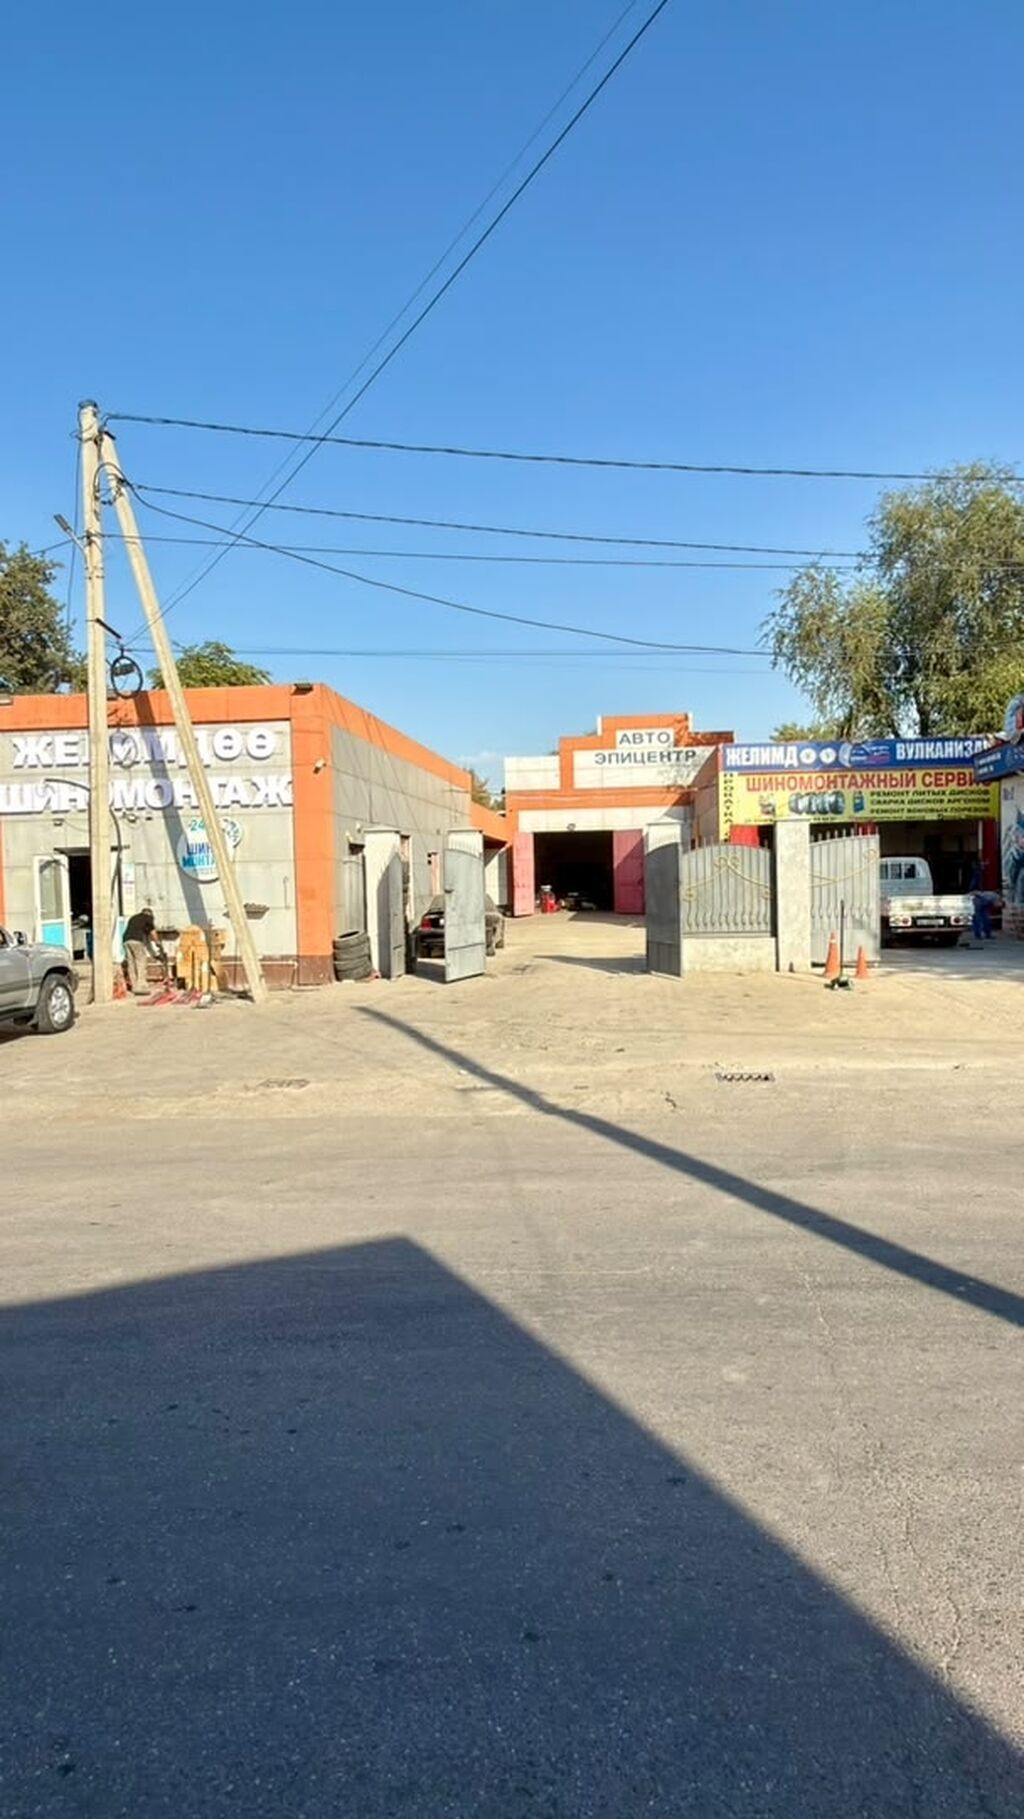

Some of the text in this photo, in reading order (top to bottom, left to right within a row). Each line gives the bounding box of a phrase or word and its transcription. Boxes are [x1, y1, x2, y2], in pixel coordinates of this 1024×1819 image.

[619, 731, 671, 745] АВТО
[11, 727, 276, 769] ЖЕИМДӨӨ
[594, 750, 697, 765] ЭПИЦЕНТР
[745, 769, 917, 792] ШИНОМОНТАЖНЫЙ
[0, 774, 293, 814] ШИНМОНТАЖ
[870, 790, 910, 798] РЕМОНТ
[912, 789, 947, 797] ЛИТЫХ
[870, 798, 906, 806] СВАРКА
